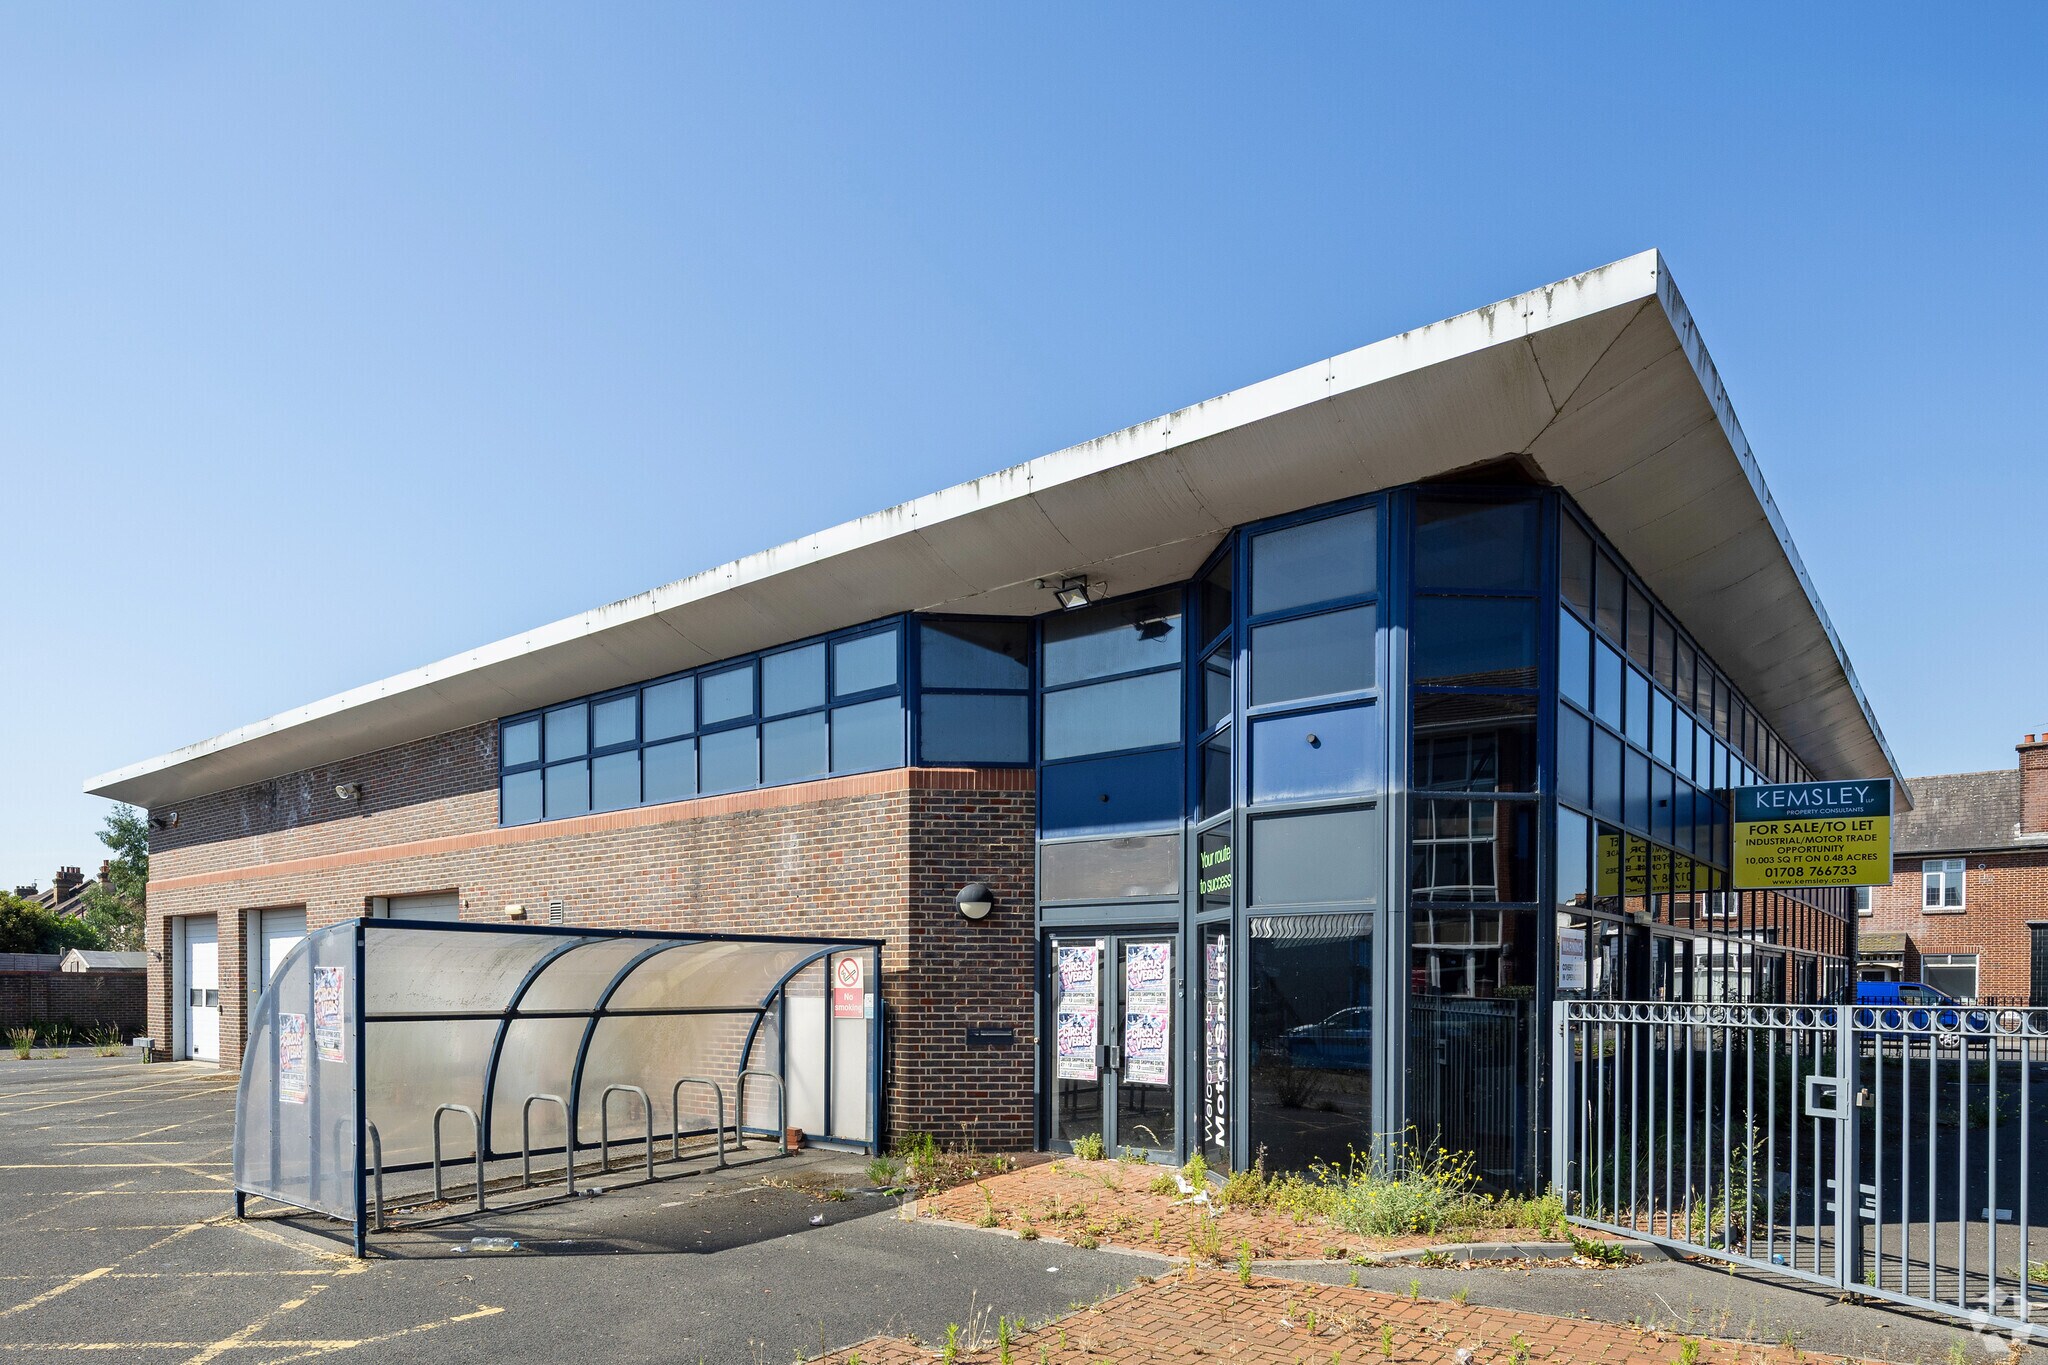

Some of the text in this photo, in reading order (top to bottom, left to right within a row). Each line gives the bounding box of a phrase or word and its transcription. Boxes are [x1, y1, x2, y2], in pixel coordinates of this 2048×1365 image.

[1756, 786, 1869, 808] KEMSLEY
[1786, 806, 1864, 816] PROPERTY CONSULTANTS
[1749, 820, 1874, 835] FOR SALE/TO LET
[1745, 834, 1877, 846] INDUSTRIAL/MOTOR TRADE
[1777, 844, 1845, 854] OPPORTUNITY
[1201, 845, 1231, 868] Your route
[1745, 853, 1878, 865] 10,003 SQ FT ON 0.48 ACRES
[1765, 865, 1857, 877] 01708 766733
[1200, 873, 1232, 894] to success
[1772, 877, 1850, 885] www.kemsley.com
[1063, 960, 1091, 972] CIRCUS
[1132, 959, 1162, 971] CIRCUS
[1068, 969, 1092, 984] VEGAS
[1137, 968, 1163, 983] VEGAS
[835, 1003, 862, 1014] smoking
[1204, 1000, 1212, 1024] to
[1063, 1026, 1091, 1038] CIRCUS
[1131, 1027, 1161, 1039] CIRCUS
[1068, 1035, 1091, 1050] VEGAS
[1136, 1036, 1163, 1051] VEGAS
[1215, 933, 1226, 1147] MotorSports
[1205, 1031, 1213, 1141] Welcome
